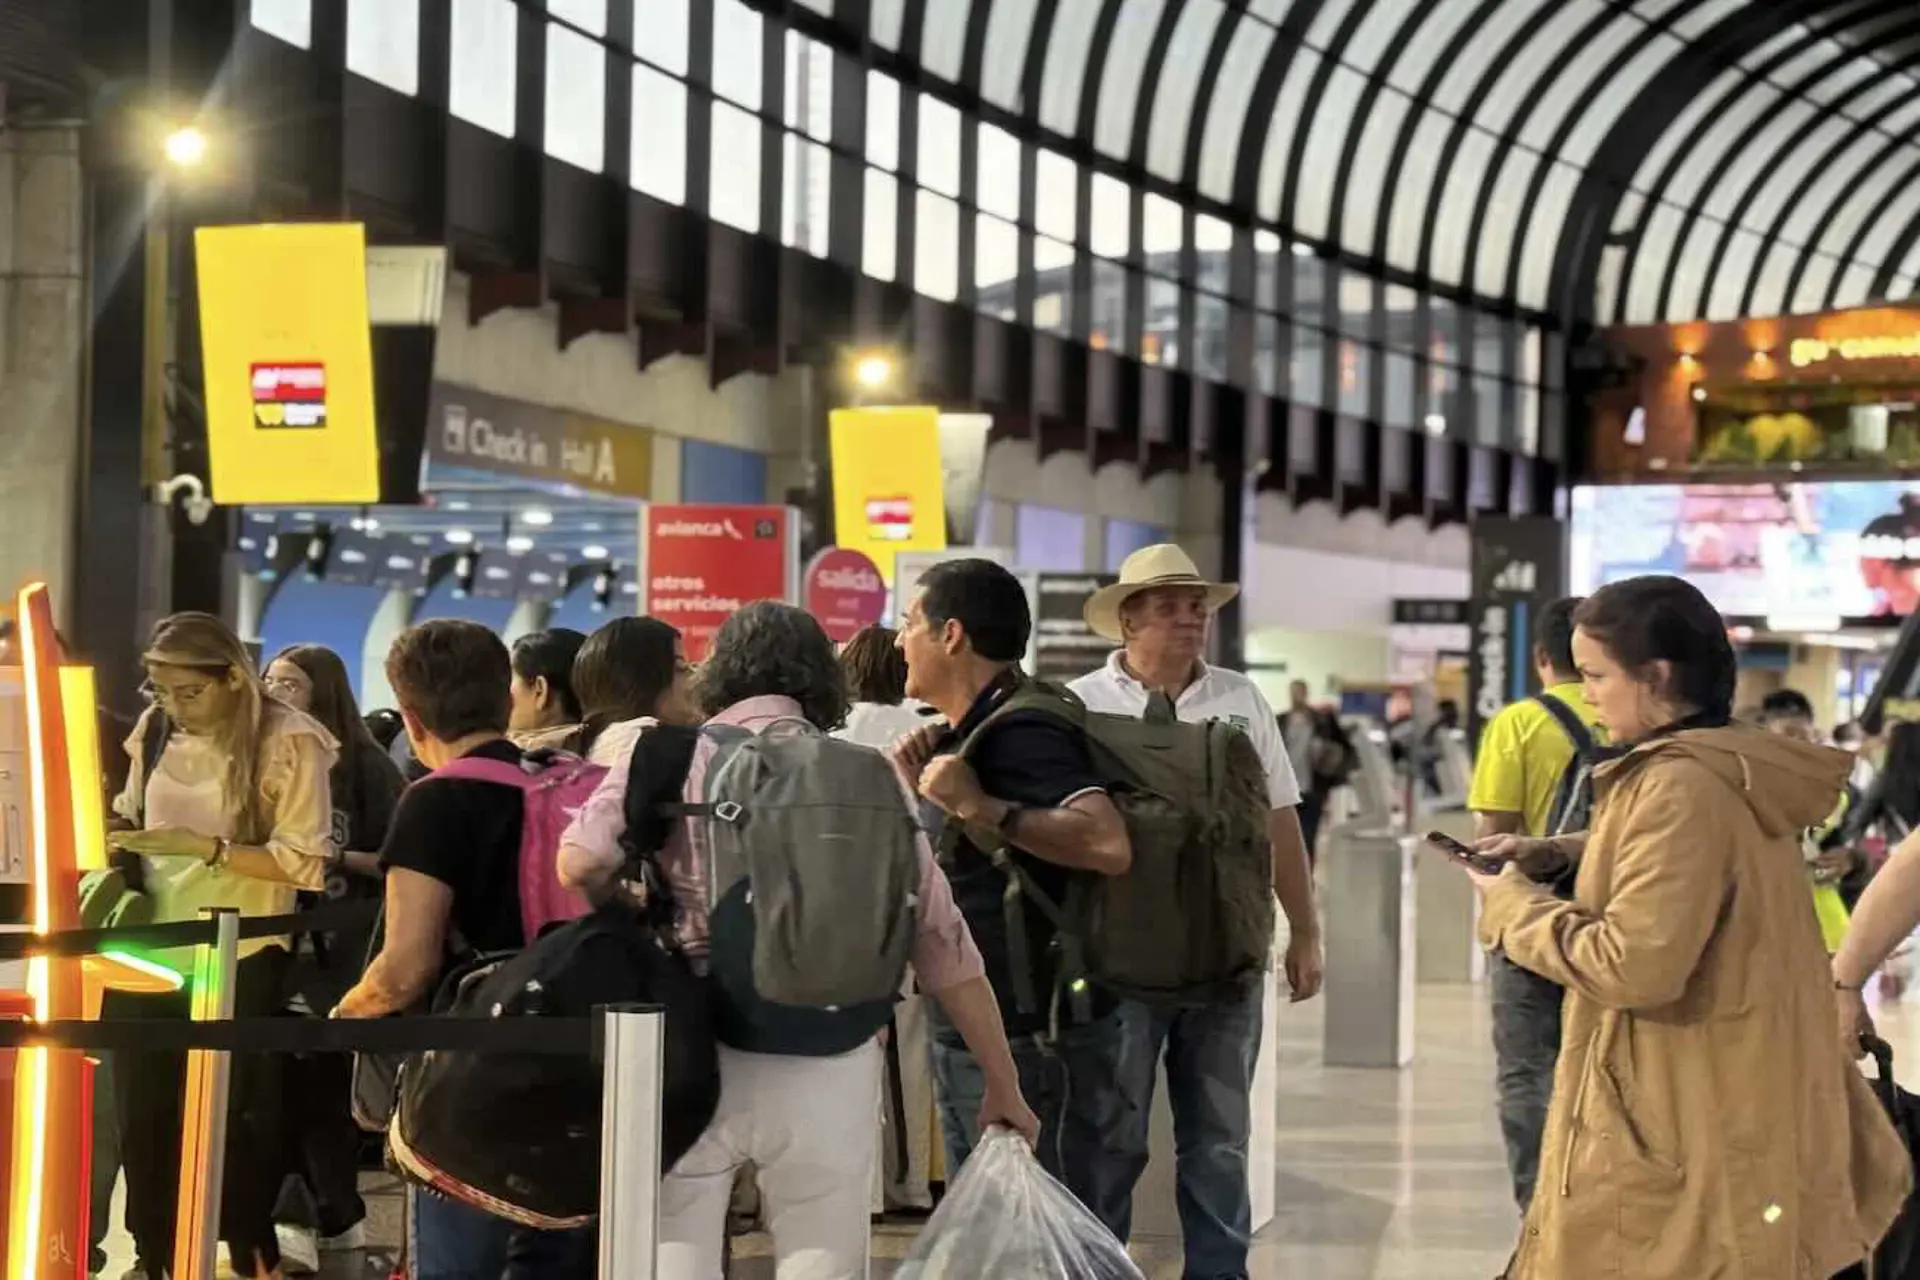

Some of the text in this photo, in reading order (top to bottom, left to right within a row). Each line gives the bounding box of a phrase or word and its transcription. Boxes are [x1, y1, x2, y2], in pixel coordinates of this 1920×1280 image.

[469, 417, 527, 464] Check
[529, 431, 547, 467] in
[594, 437, 616, 485] A
[656, 519, 724, 537] avianca
[652, 575, 704, 591] otros
[817, 566, 879, 593] salida
[652, 593, 740, 612] servicios
